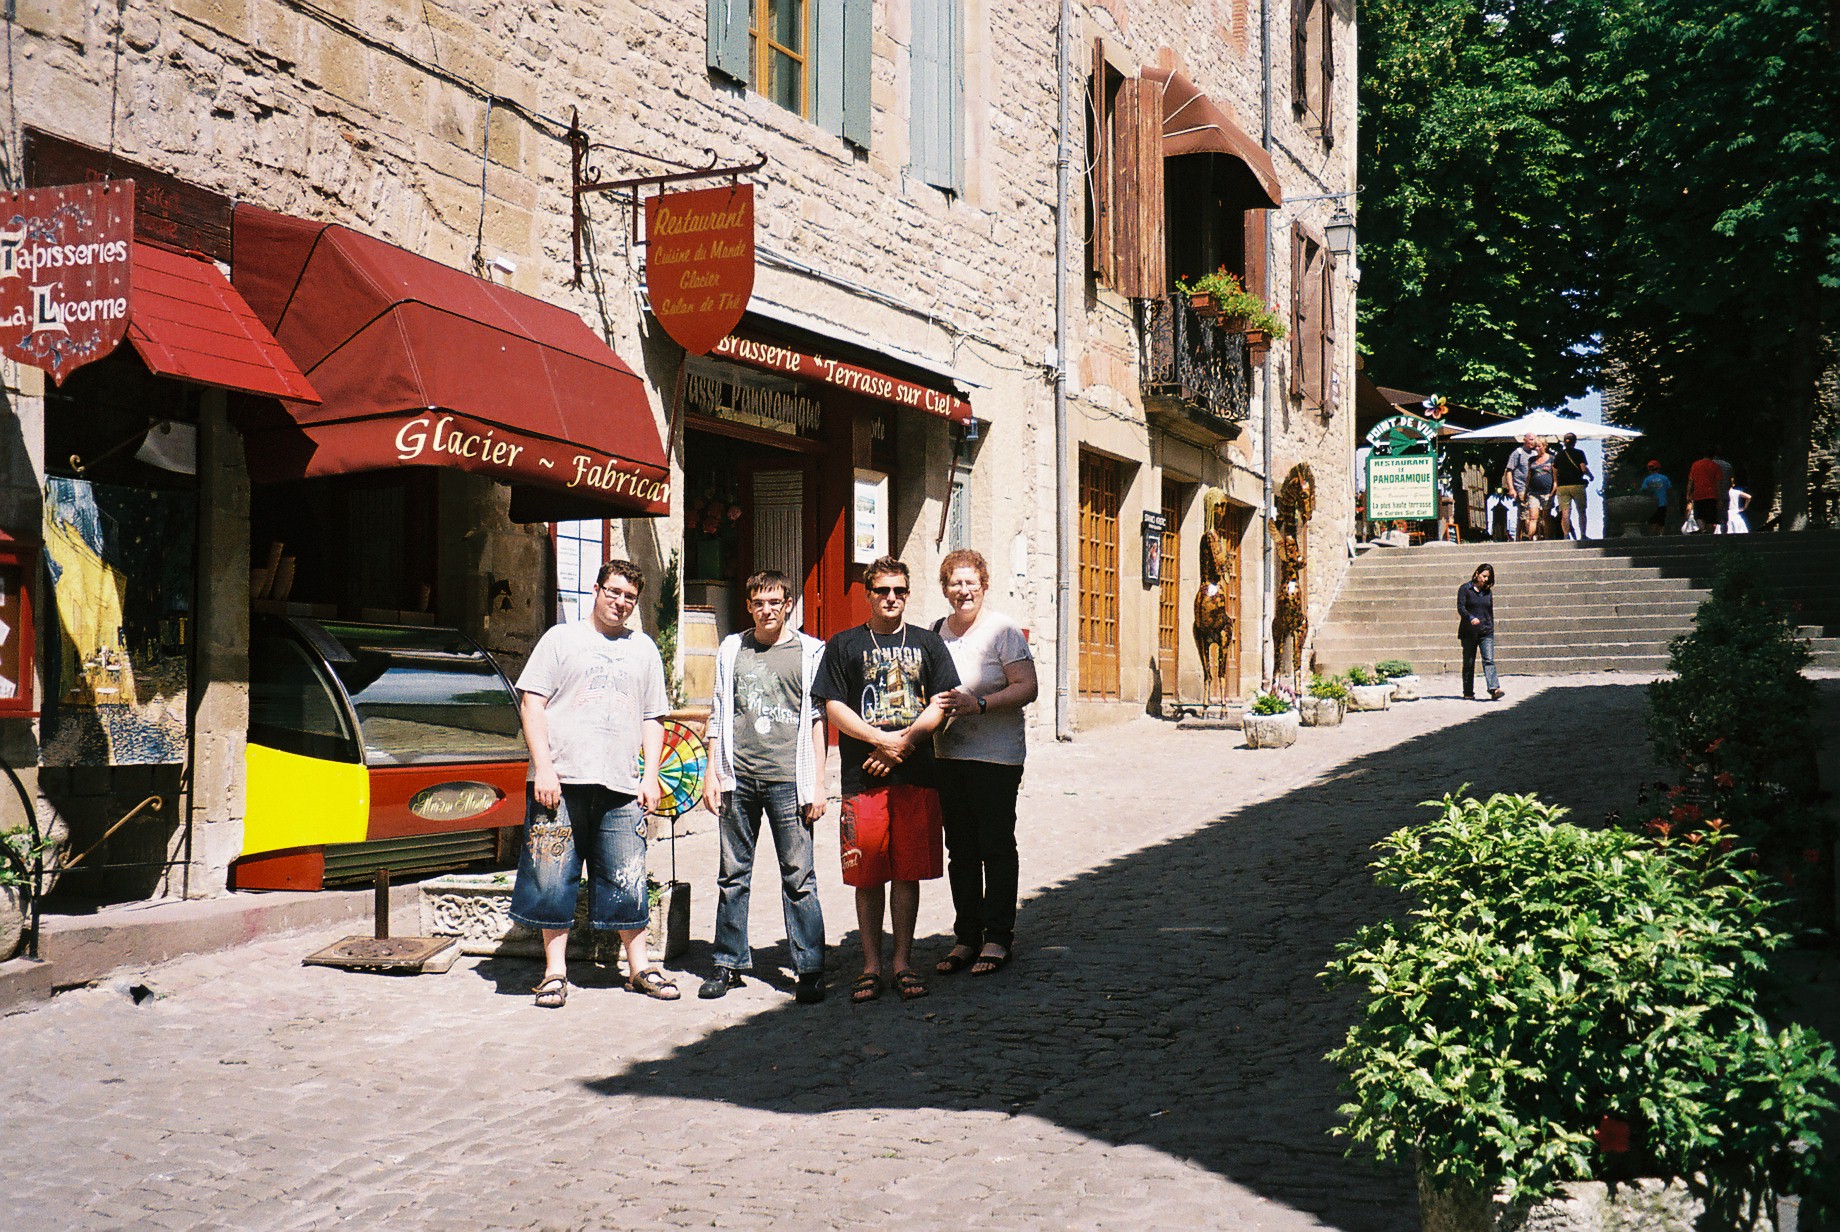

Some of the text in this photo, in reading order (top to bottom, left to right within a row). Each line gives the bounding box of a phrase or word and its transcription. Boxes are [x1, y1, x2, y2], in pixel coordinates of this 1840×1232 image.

[654, 203, 747, 236] Restaurant
[0, 215, 127, 282] Tapisseries
[654, 246, 691, 265] Cuisine
[694, 243, 706, 261] du
[679, 270, 720, 289] Glacier
[28, 282, 126, 335] Licorne
[699, 296, 714, 312] de
[717, 335, 800, 371] Brasserie
[896, 384, 922, 406] sur
[395, 416, 523, 468] Glacier
[1366, 417, 1437, 446] POINT DE VUE
[1373, 473, 1431, 484] PANORAMIQUE
[863, 646, 922, 663] LONDON
